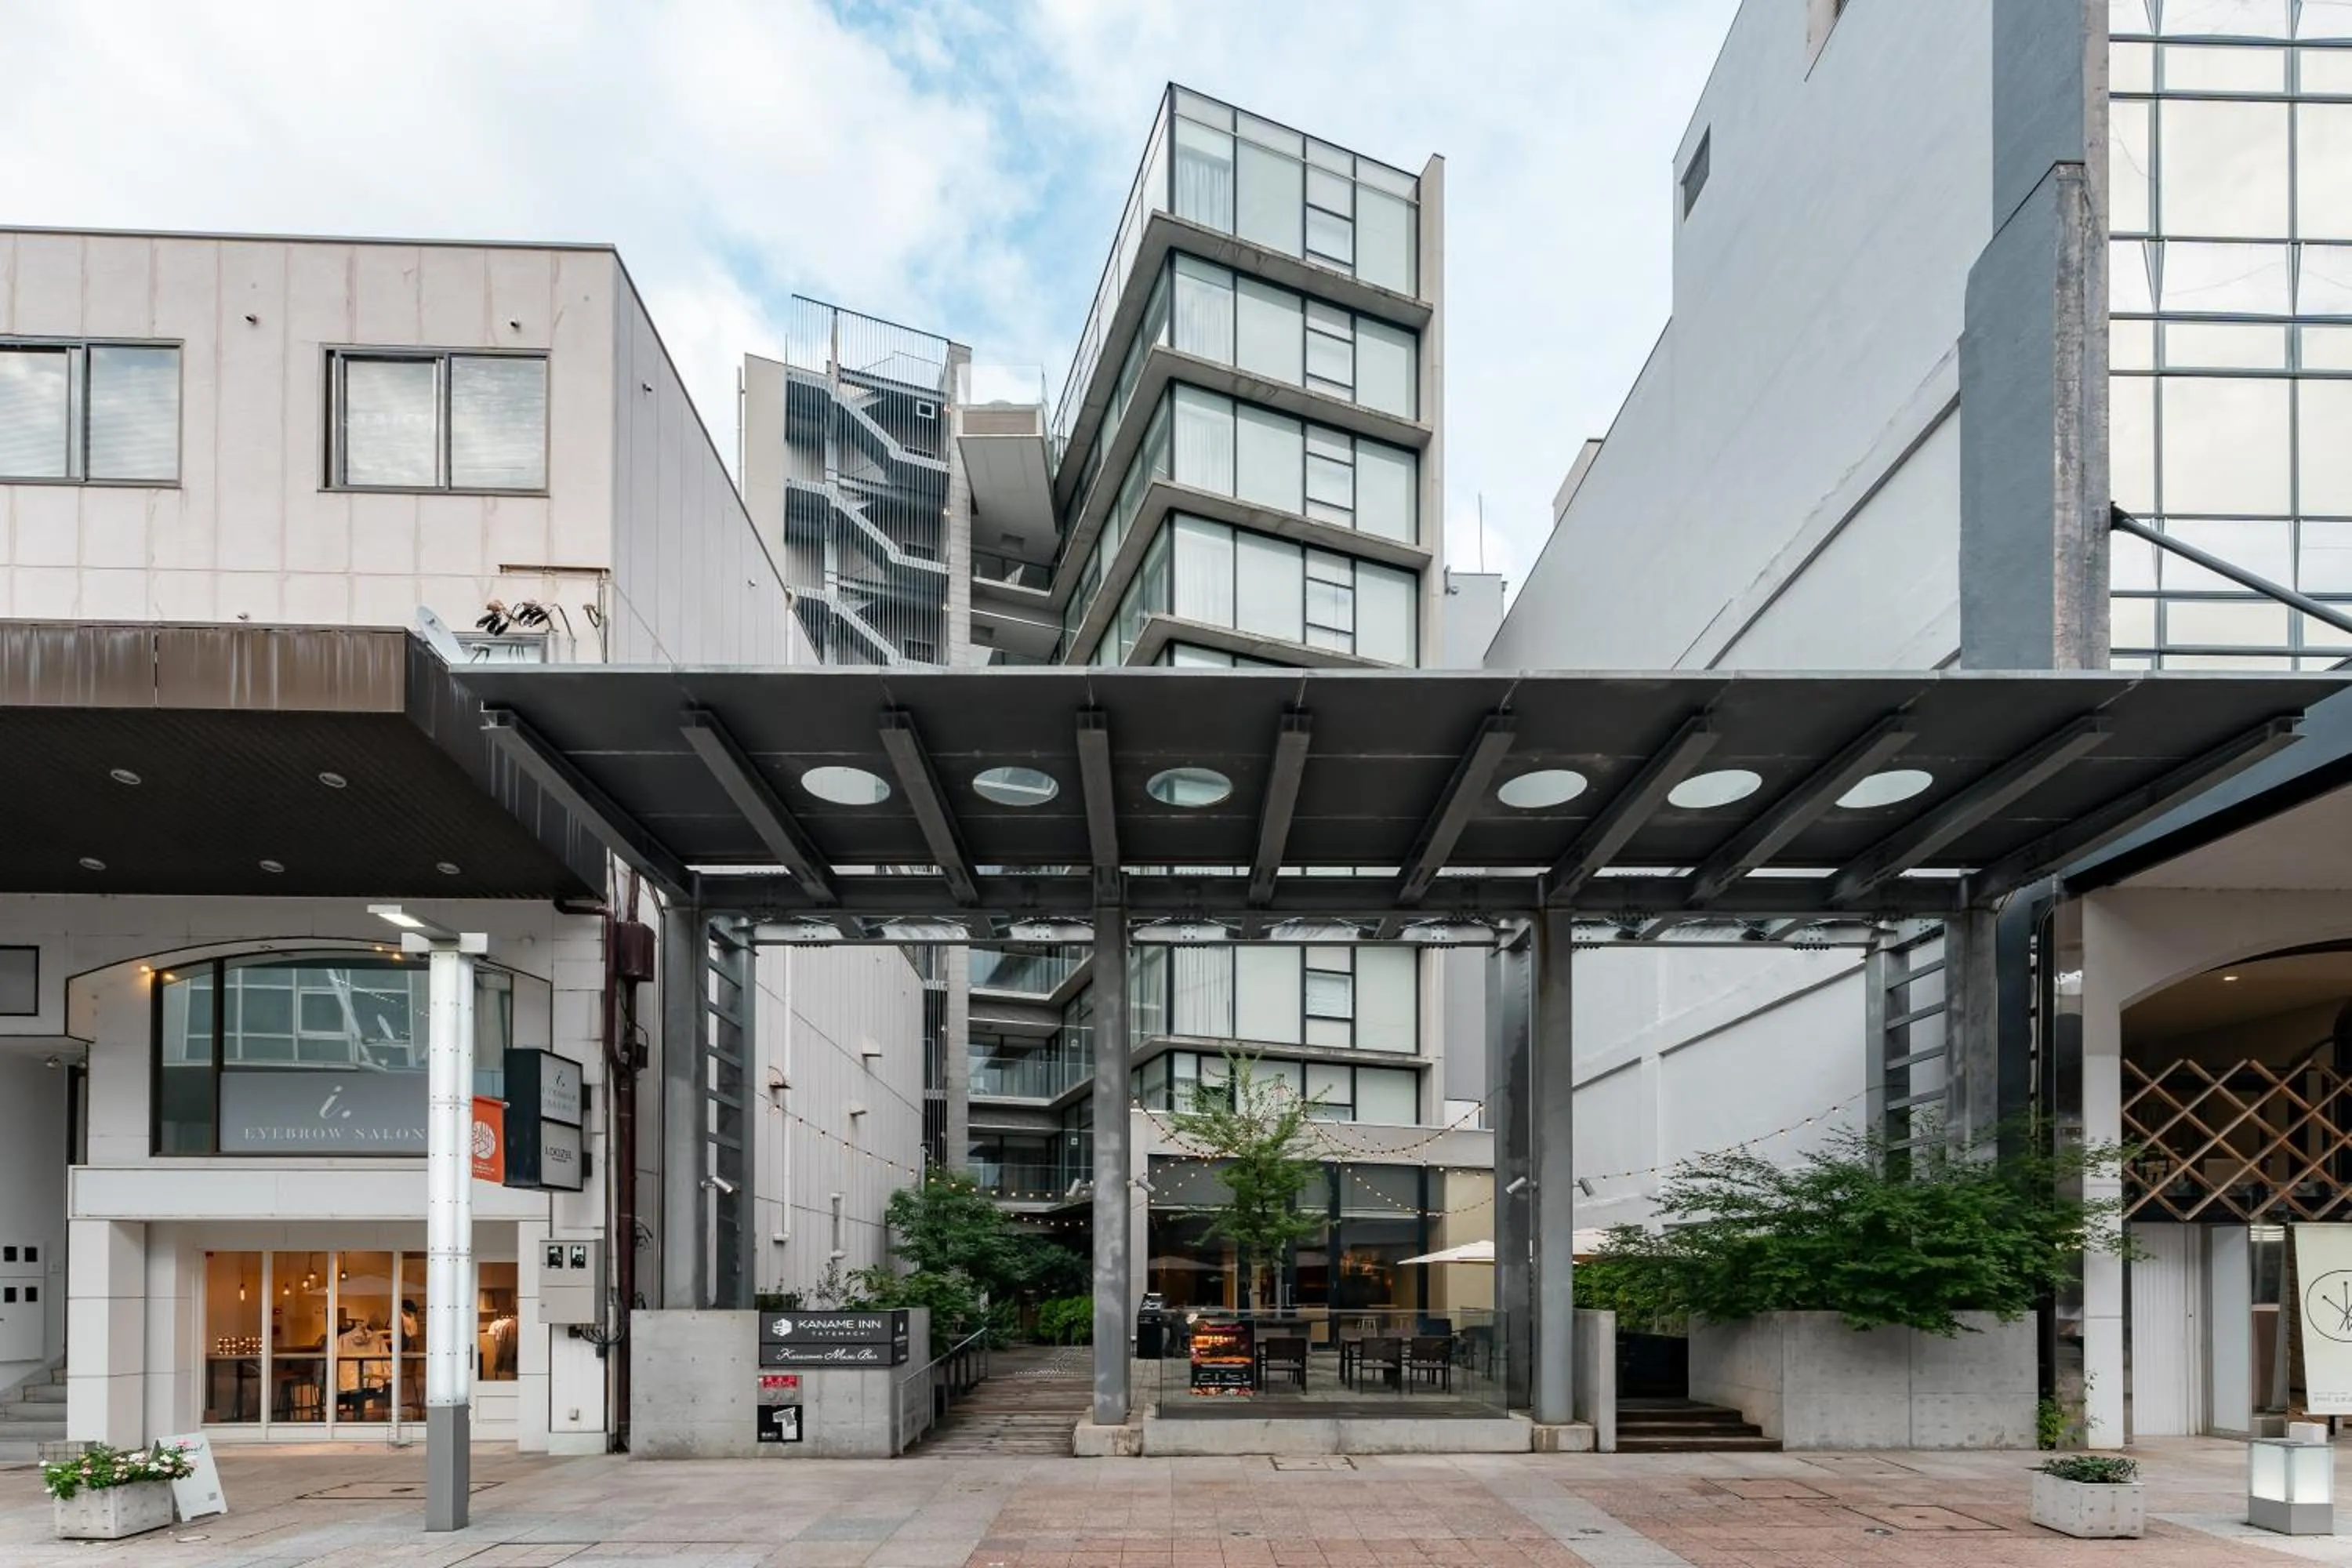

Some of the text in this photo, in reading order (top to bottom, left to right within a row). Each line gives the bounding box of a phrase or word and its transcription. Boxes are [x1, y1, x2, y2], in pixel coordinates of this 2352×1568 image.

[245, 1127, 426, 1140] EYEBROW SALON
[797, 1319, 881, 1329] KANAME INN
